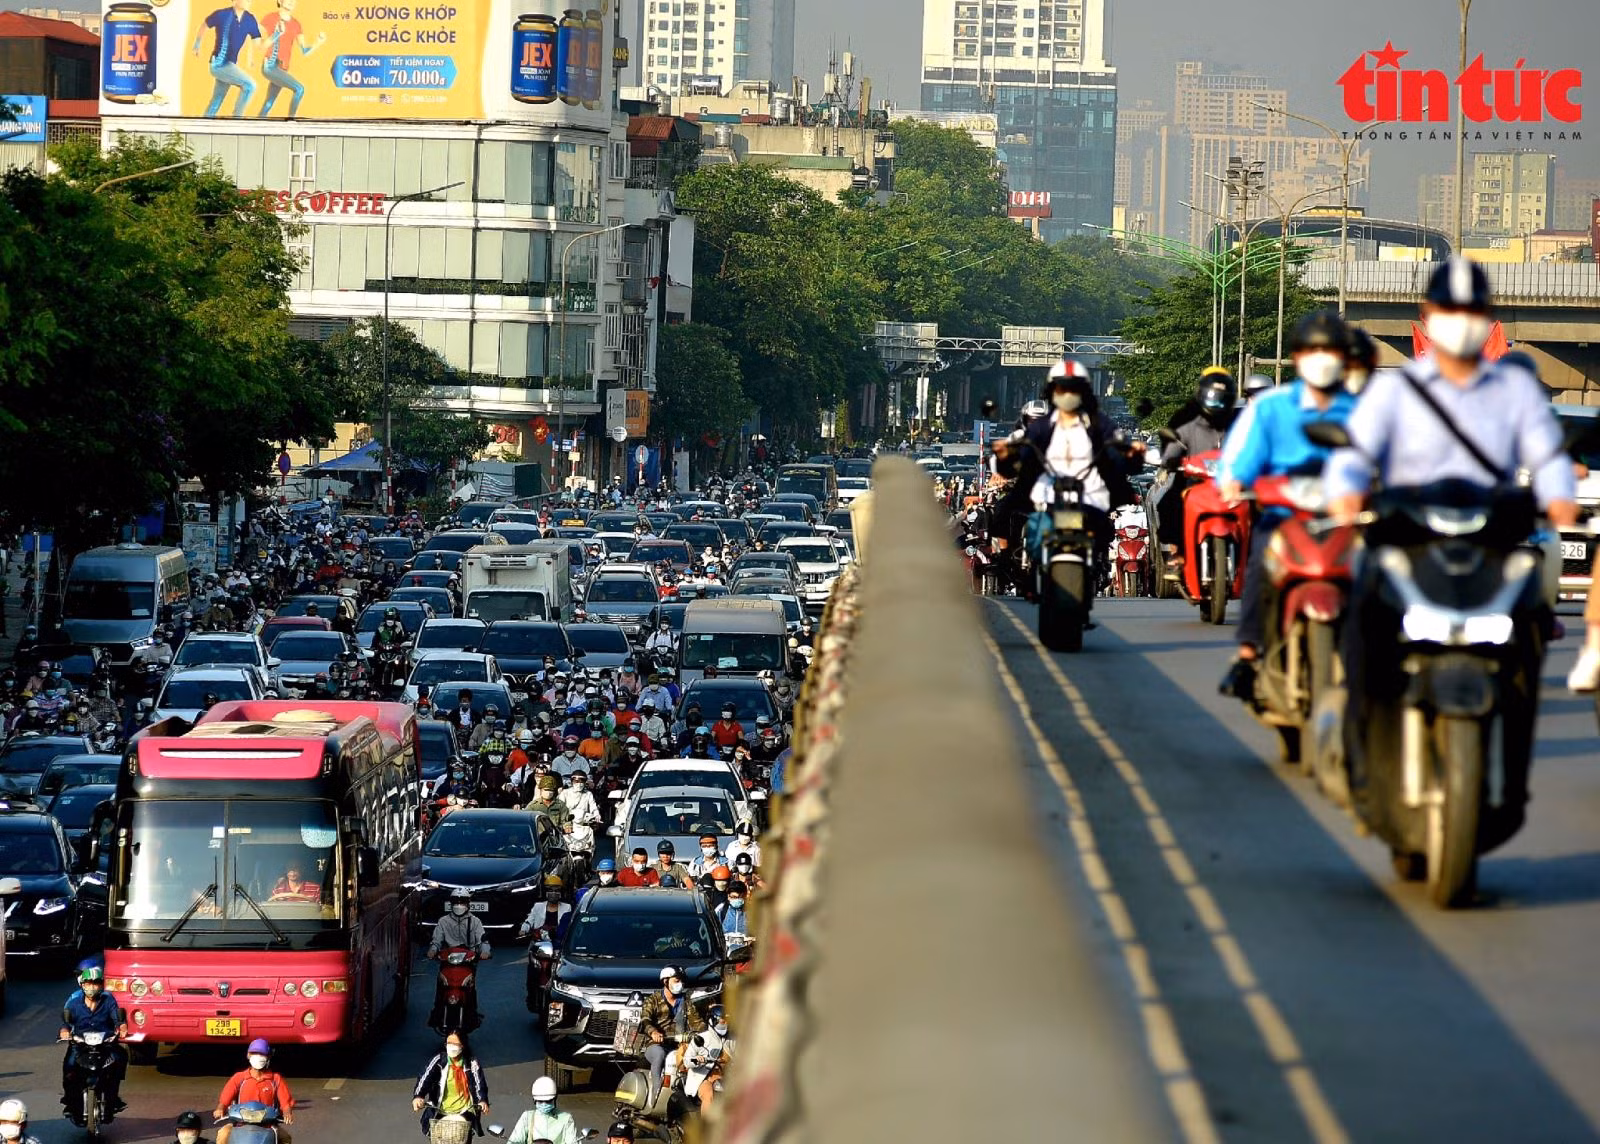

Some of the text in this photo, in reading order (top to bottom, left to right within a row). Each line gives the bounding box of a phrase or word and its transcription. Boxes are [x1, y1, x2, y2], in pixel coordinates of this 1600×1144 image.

[354, 4, 411, 20] XƯƠNG
[415, 3, 457, 20] KHỚP
[366, 23, 411, 43] CHẮC
[112, 34, 148, 62] JEX
[520, 41, 552, 67] JEX
[342, 58, 362, 67] CHAI
[424, 58, 445, 67] NGAY
[342, 70, 362, 85] 60
